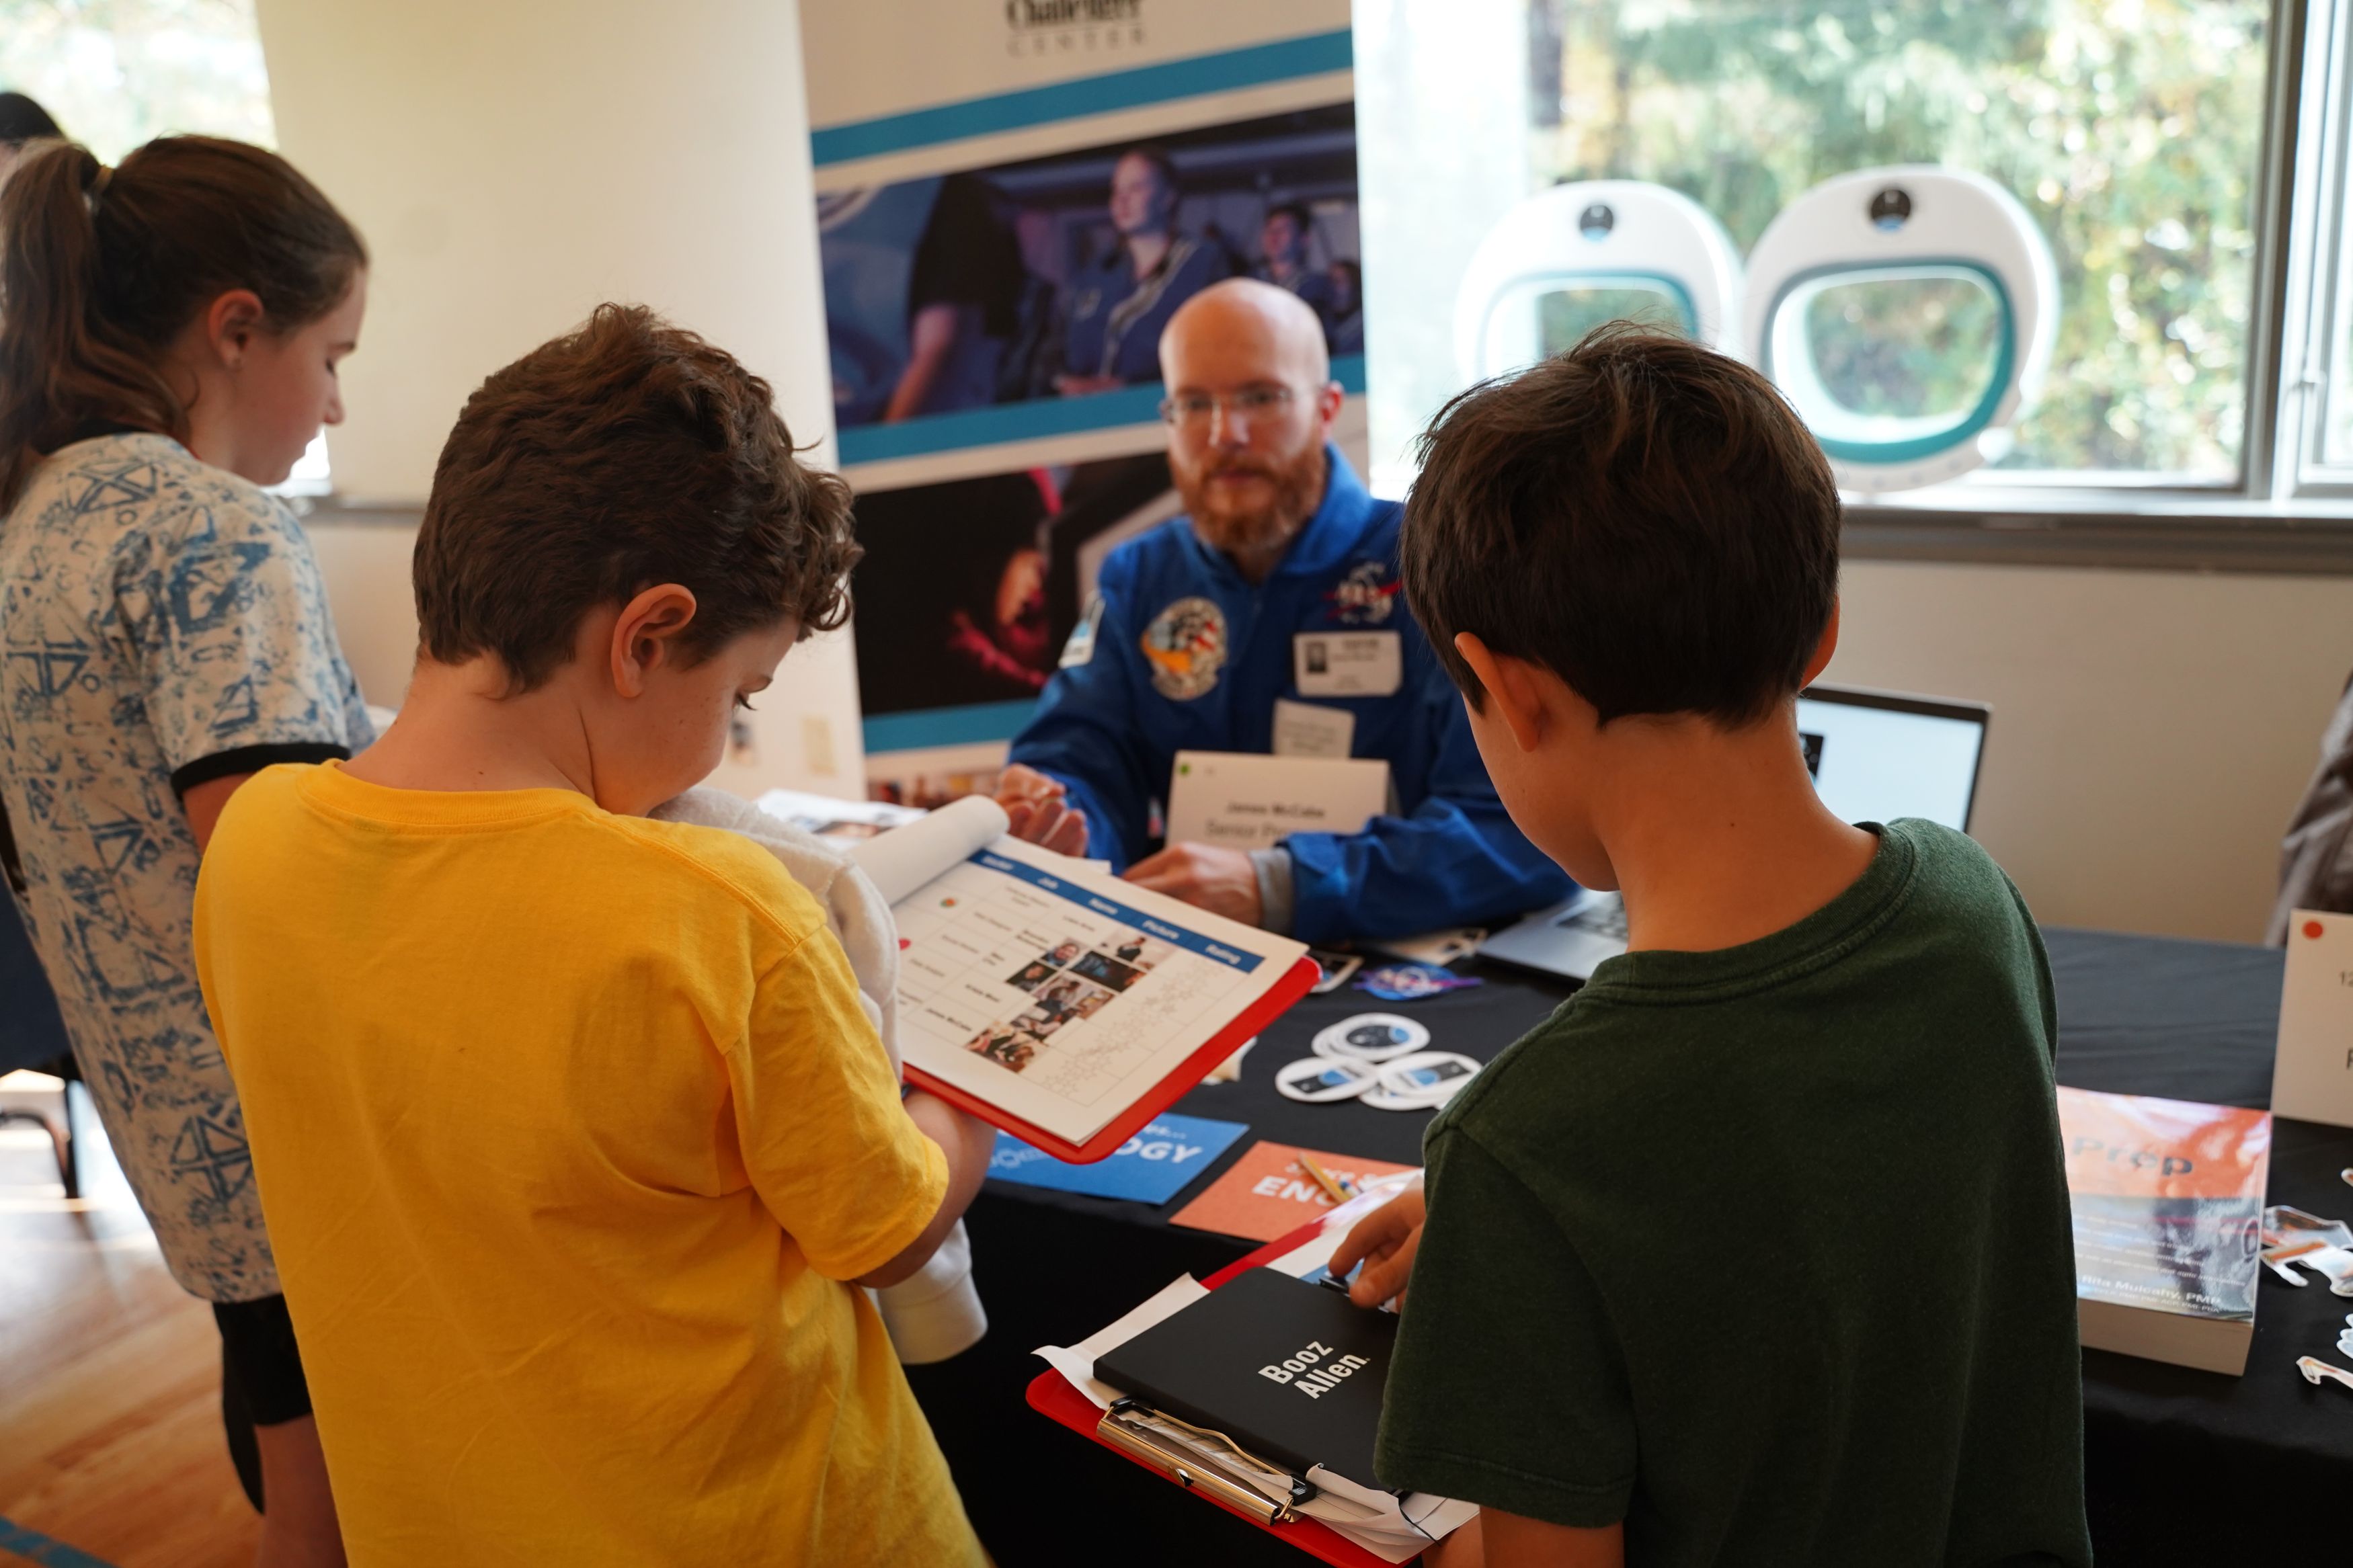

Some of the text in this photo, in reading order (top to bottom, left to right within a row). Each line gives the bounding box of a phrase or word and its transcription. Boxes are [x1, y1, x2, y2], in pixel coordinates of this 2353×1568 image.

[1142, 919, 1180, 940] Picture
[1205, 944, 1242, 965] Rating
[1257, 1340, 1334, 1385] Booz
